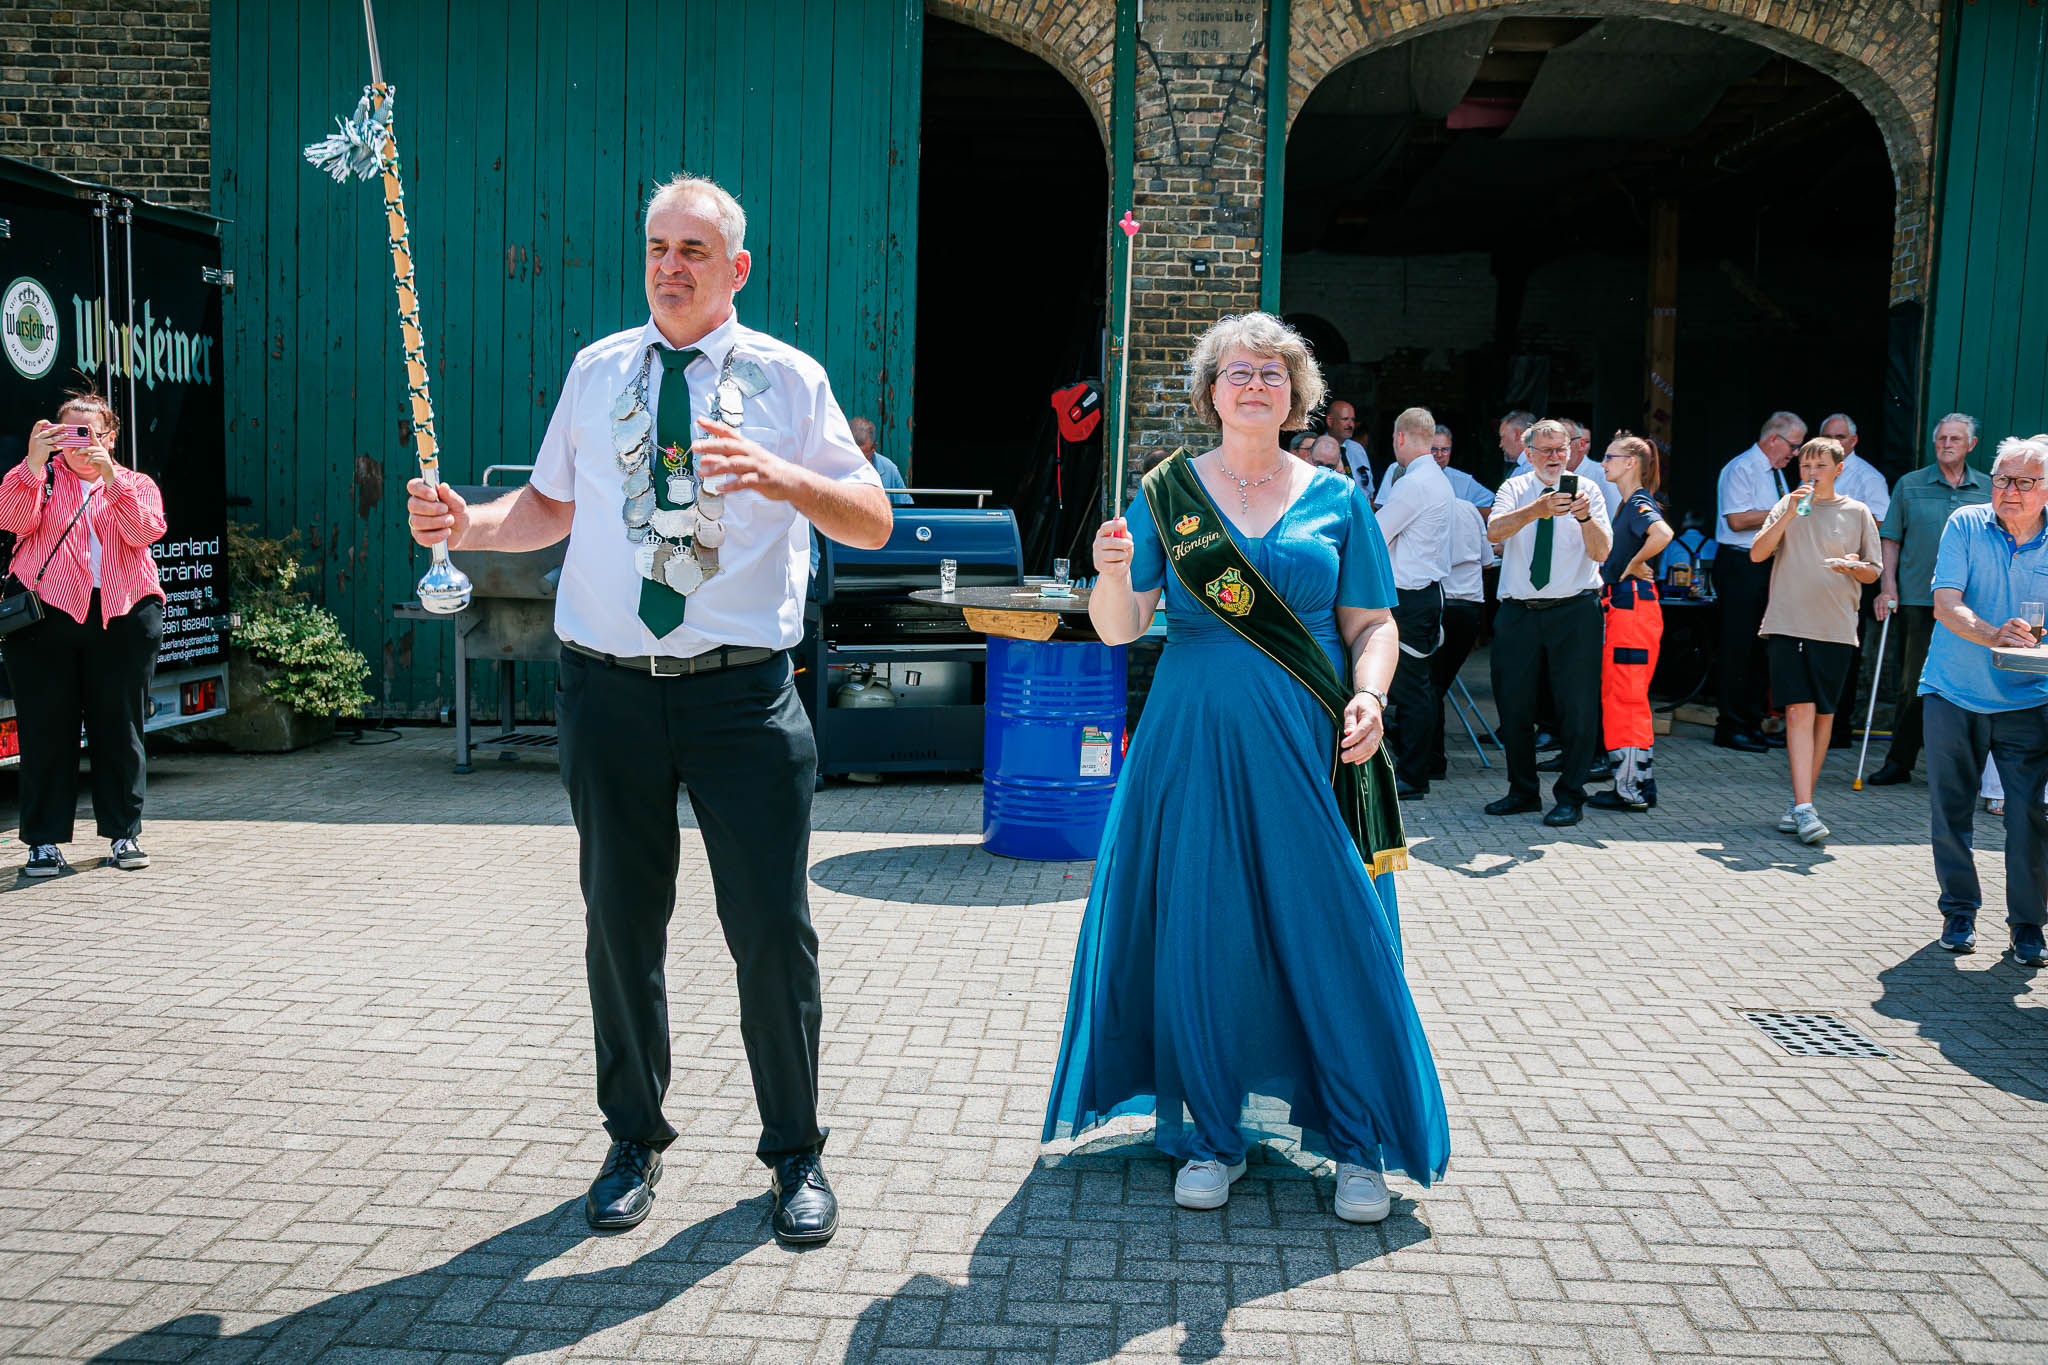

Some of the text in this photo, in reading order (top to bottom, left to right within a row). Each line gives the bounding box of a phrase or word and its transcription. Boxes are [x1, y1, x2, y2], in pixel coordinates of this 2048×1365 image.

[5, 312, 54, 341] Warsteiner
[72, 293, 213, 391] Warsteiner
[150, 536, 219, 558] auerland
[1172, 532, 1220, 560] Königin
[204, 585, 213, 598] 19
[181, 616, 210, 632] 962840
